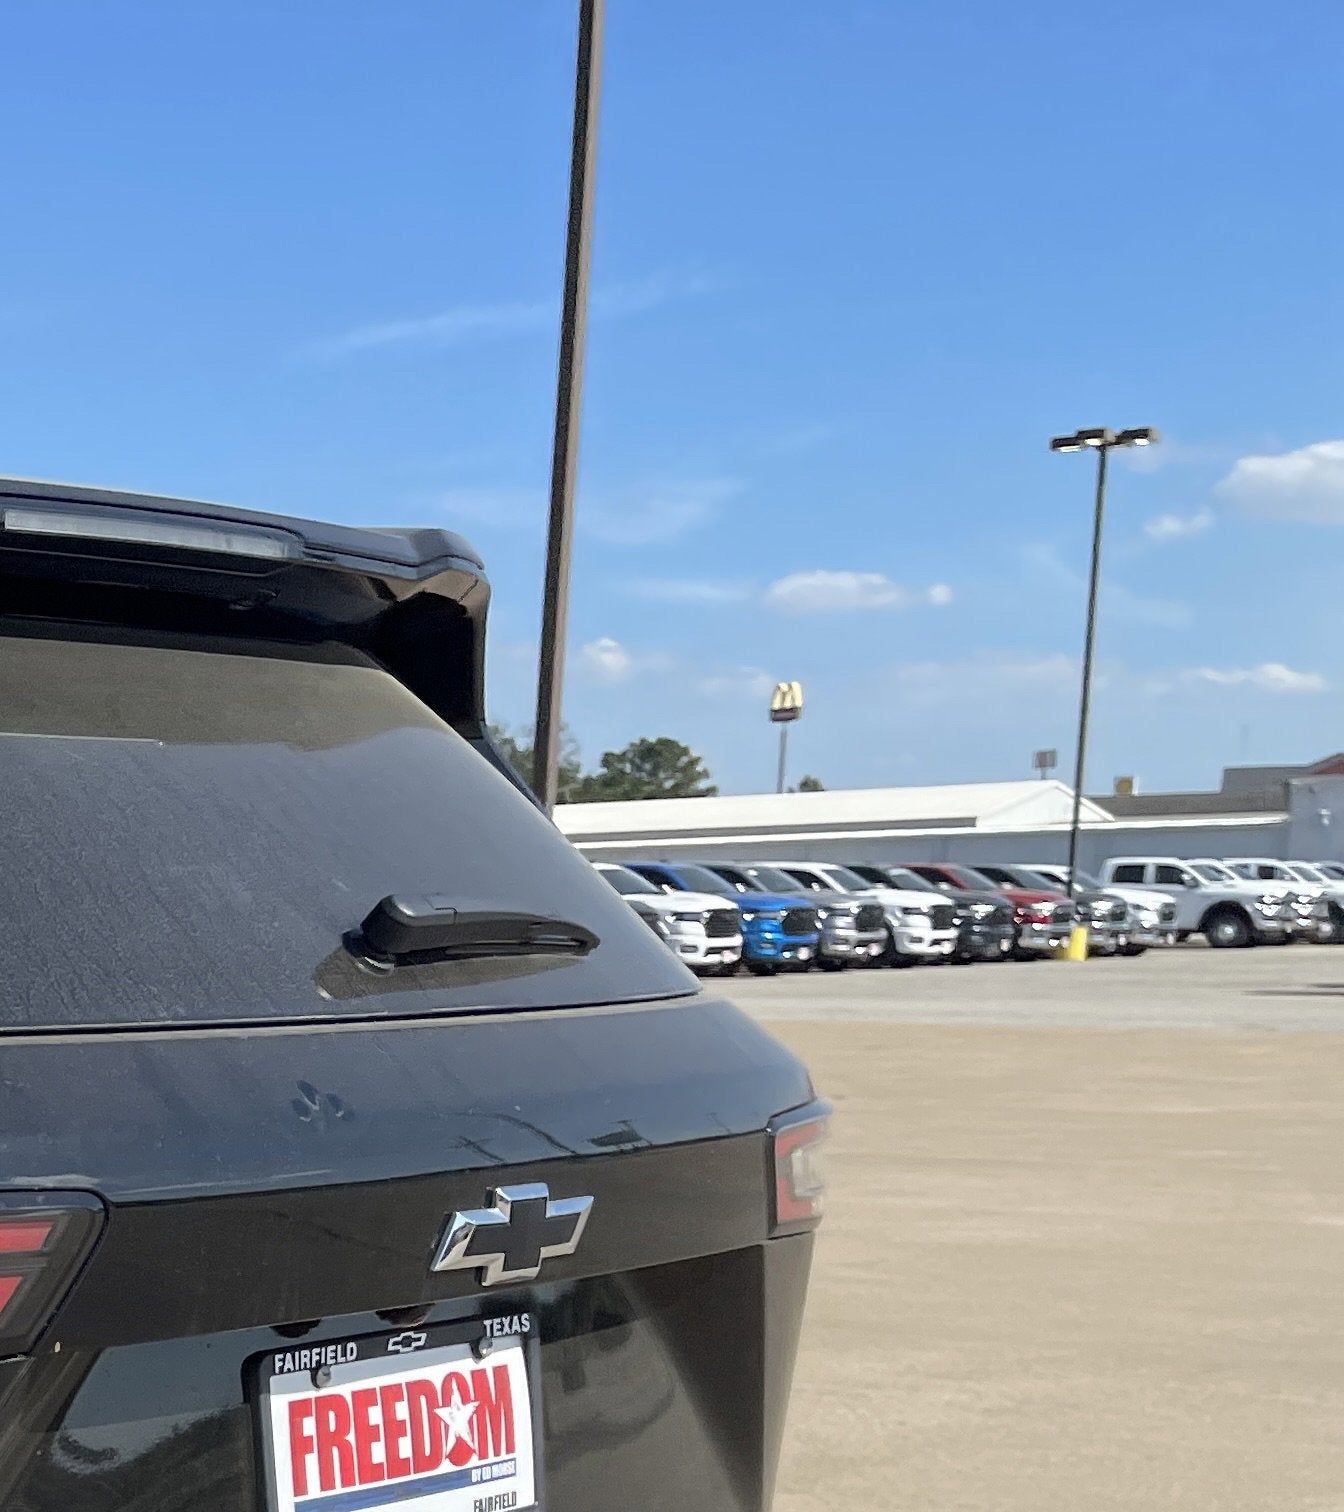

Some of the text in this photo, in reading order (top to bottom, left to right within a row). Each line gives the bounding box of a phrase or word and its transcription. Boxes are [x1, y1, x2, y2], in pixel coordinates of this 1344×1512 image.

[483, 1313, 531, 1338] TEXAS
[274, 1342, 357, 1374] FAIRFIELD
[288, 1364, 516, 1497] FREEDOM
